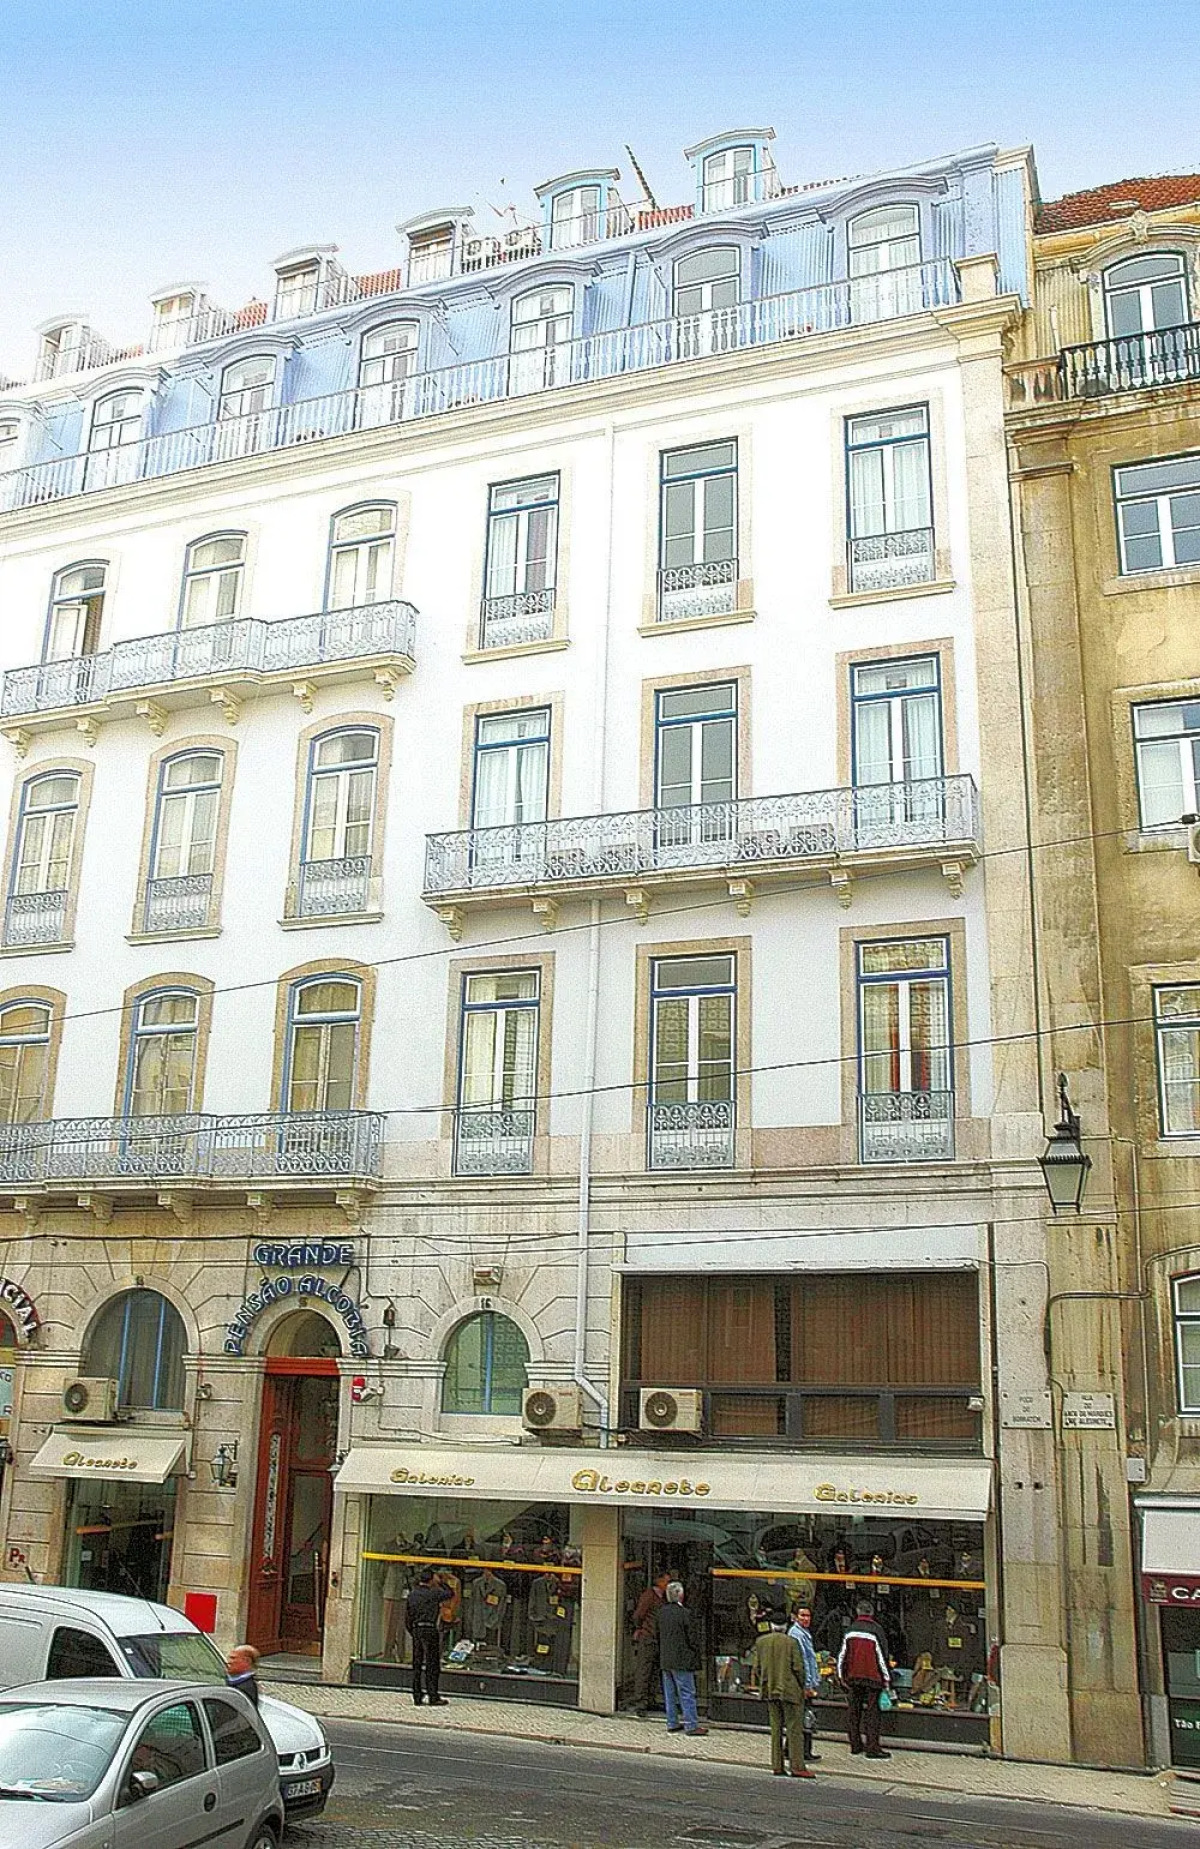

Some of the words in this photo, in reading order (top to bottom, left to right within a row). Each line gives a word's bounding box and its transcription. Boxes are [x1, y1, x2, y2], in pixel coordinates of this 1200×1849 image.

[254, 1243, 354, 1266] GRANDE
[223, 1276, 292, 1356] PENSÃO
[298, 1273, 368, 1356] ALCOBIA
